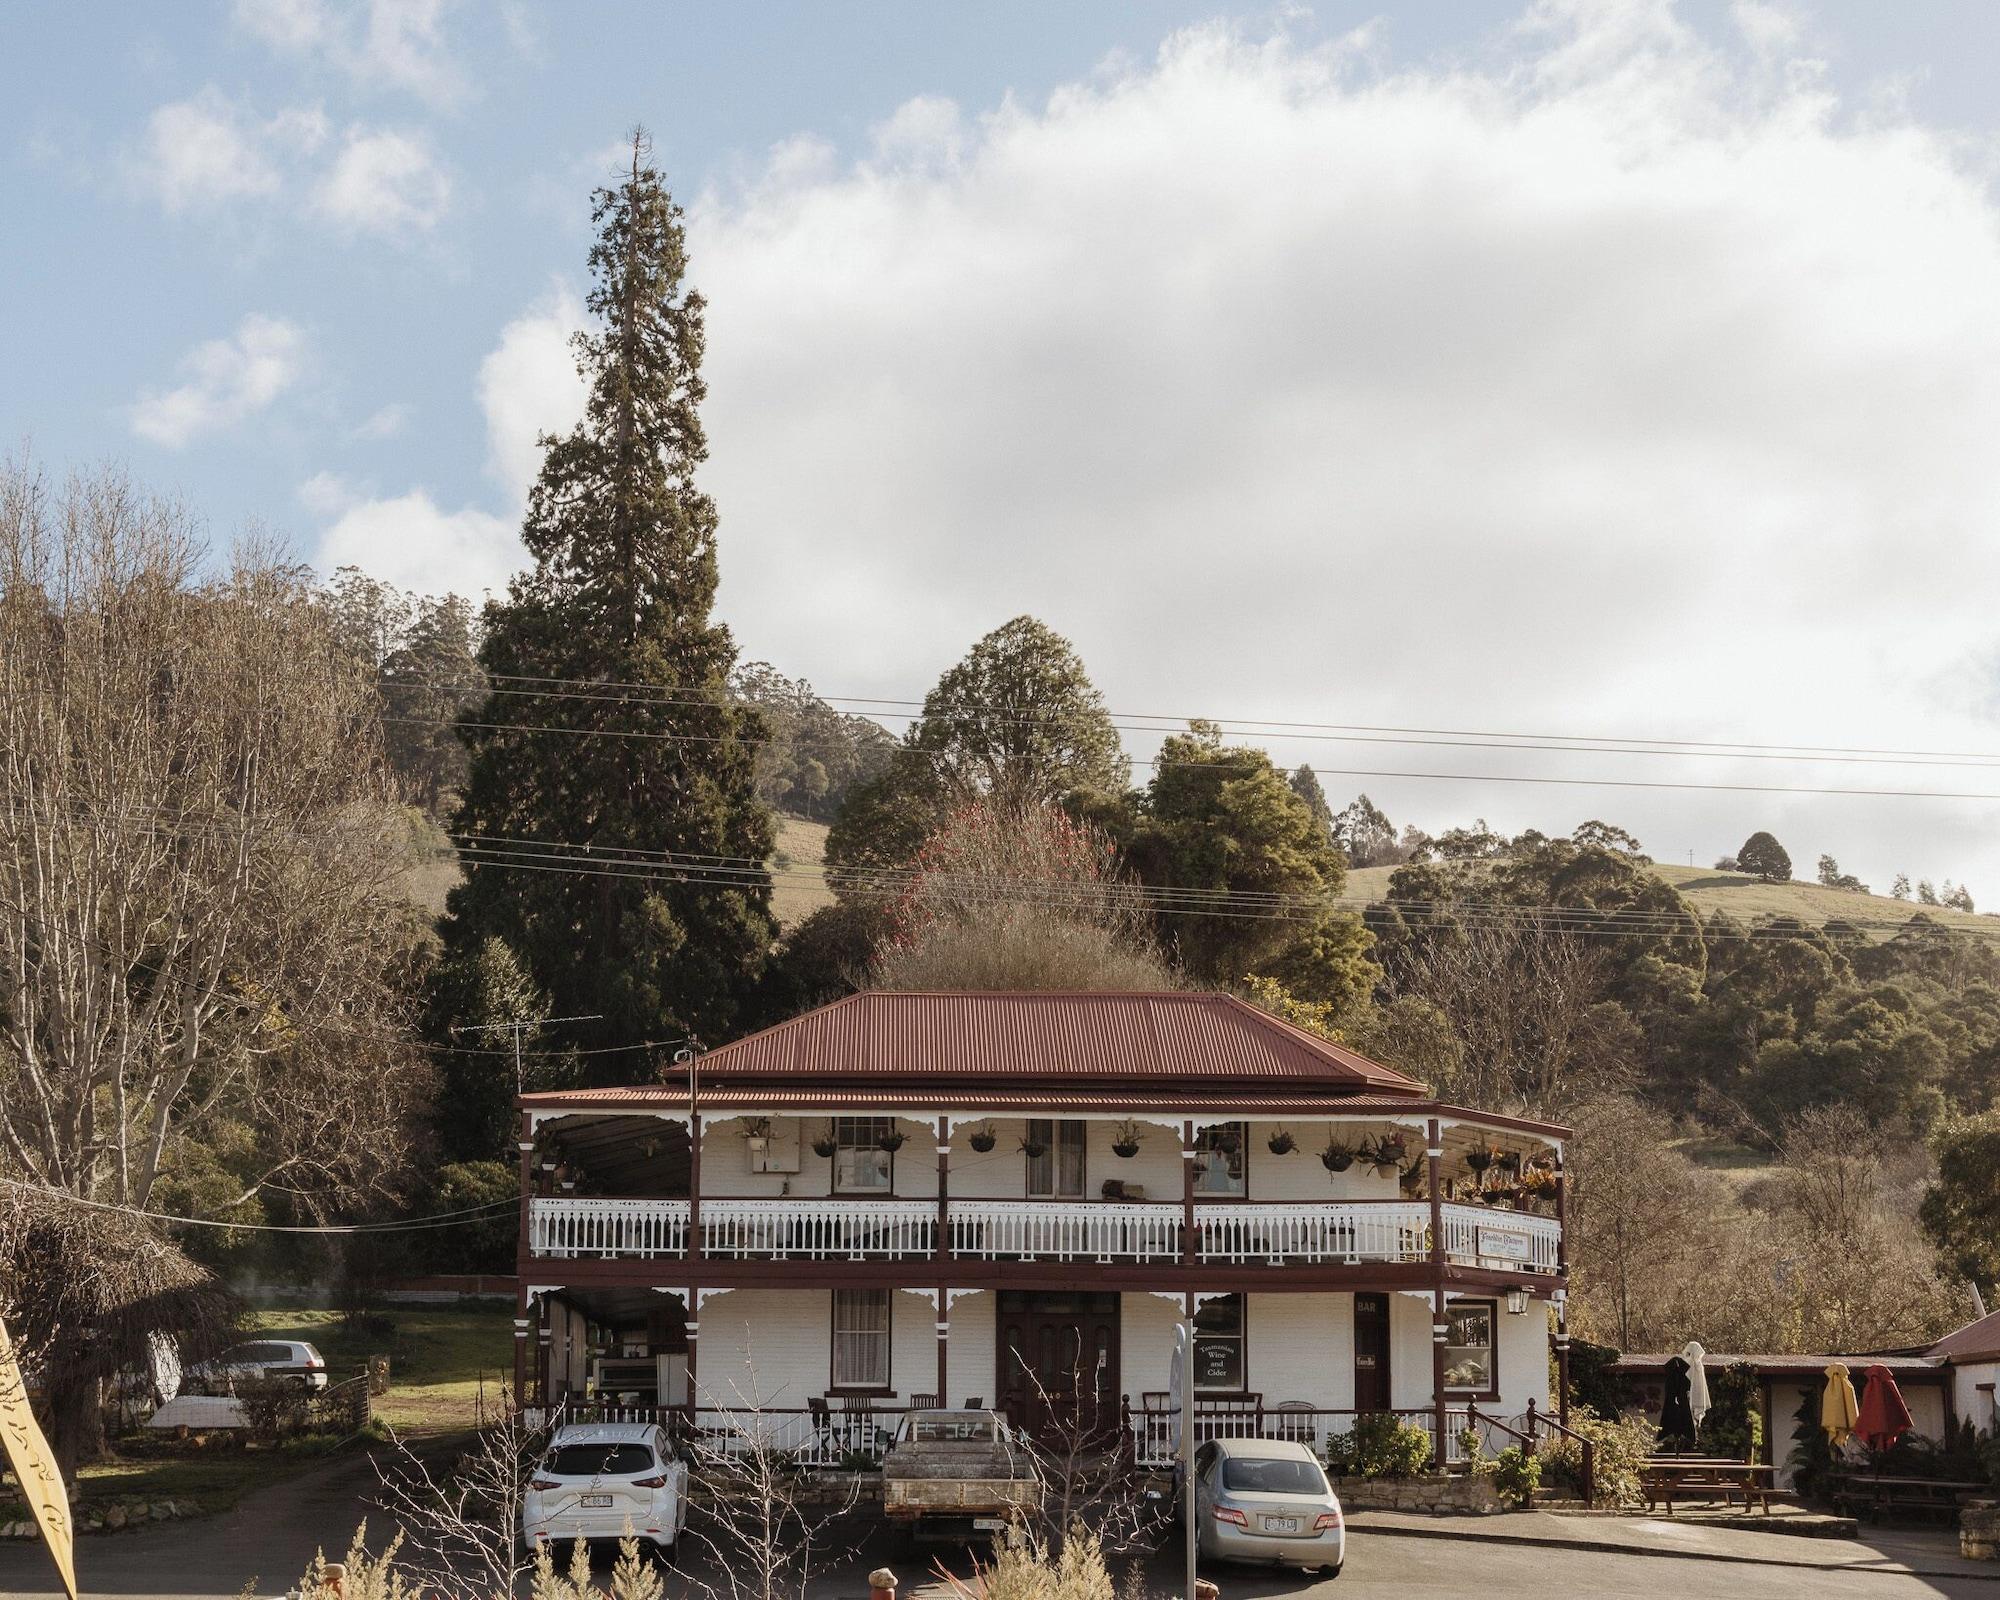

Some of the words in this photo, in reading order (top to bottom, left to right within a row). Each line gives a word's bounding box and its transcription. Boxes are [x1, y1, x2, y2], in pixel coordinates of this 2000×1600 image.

[1357, 1301, 1376, 1312] BAR
[1200, 1345, 1234, 1354] Tasmanian
[1208, 1351, 1226, 1359] Wine
